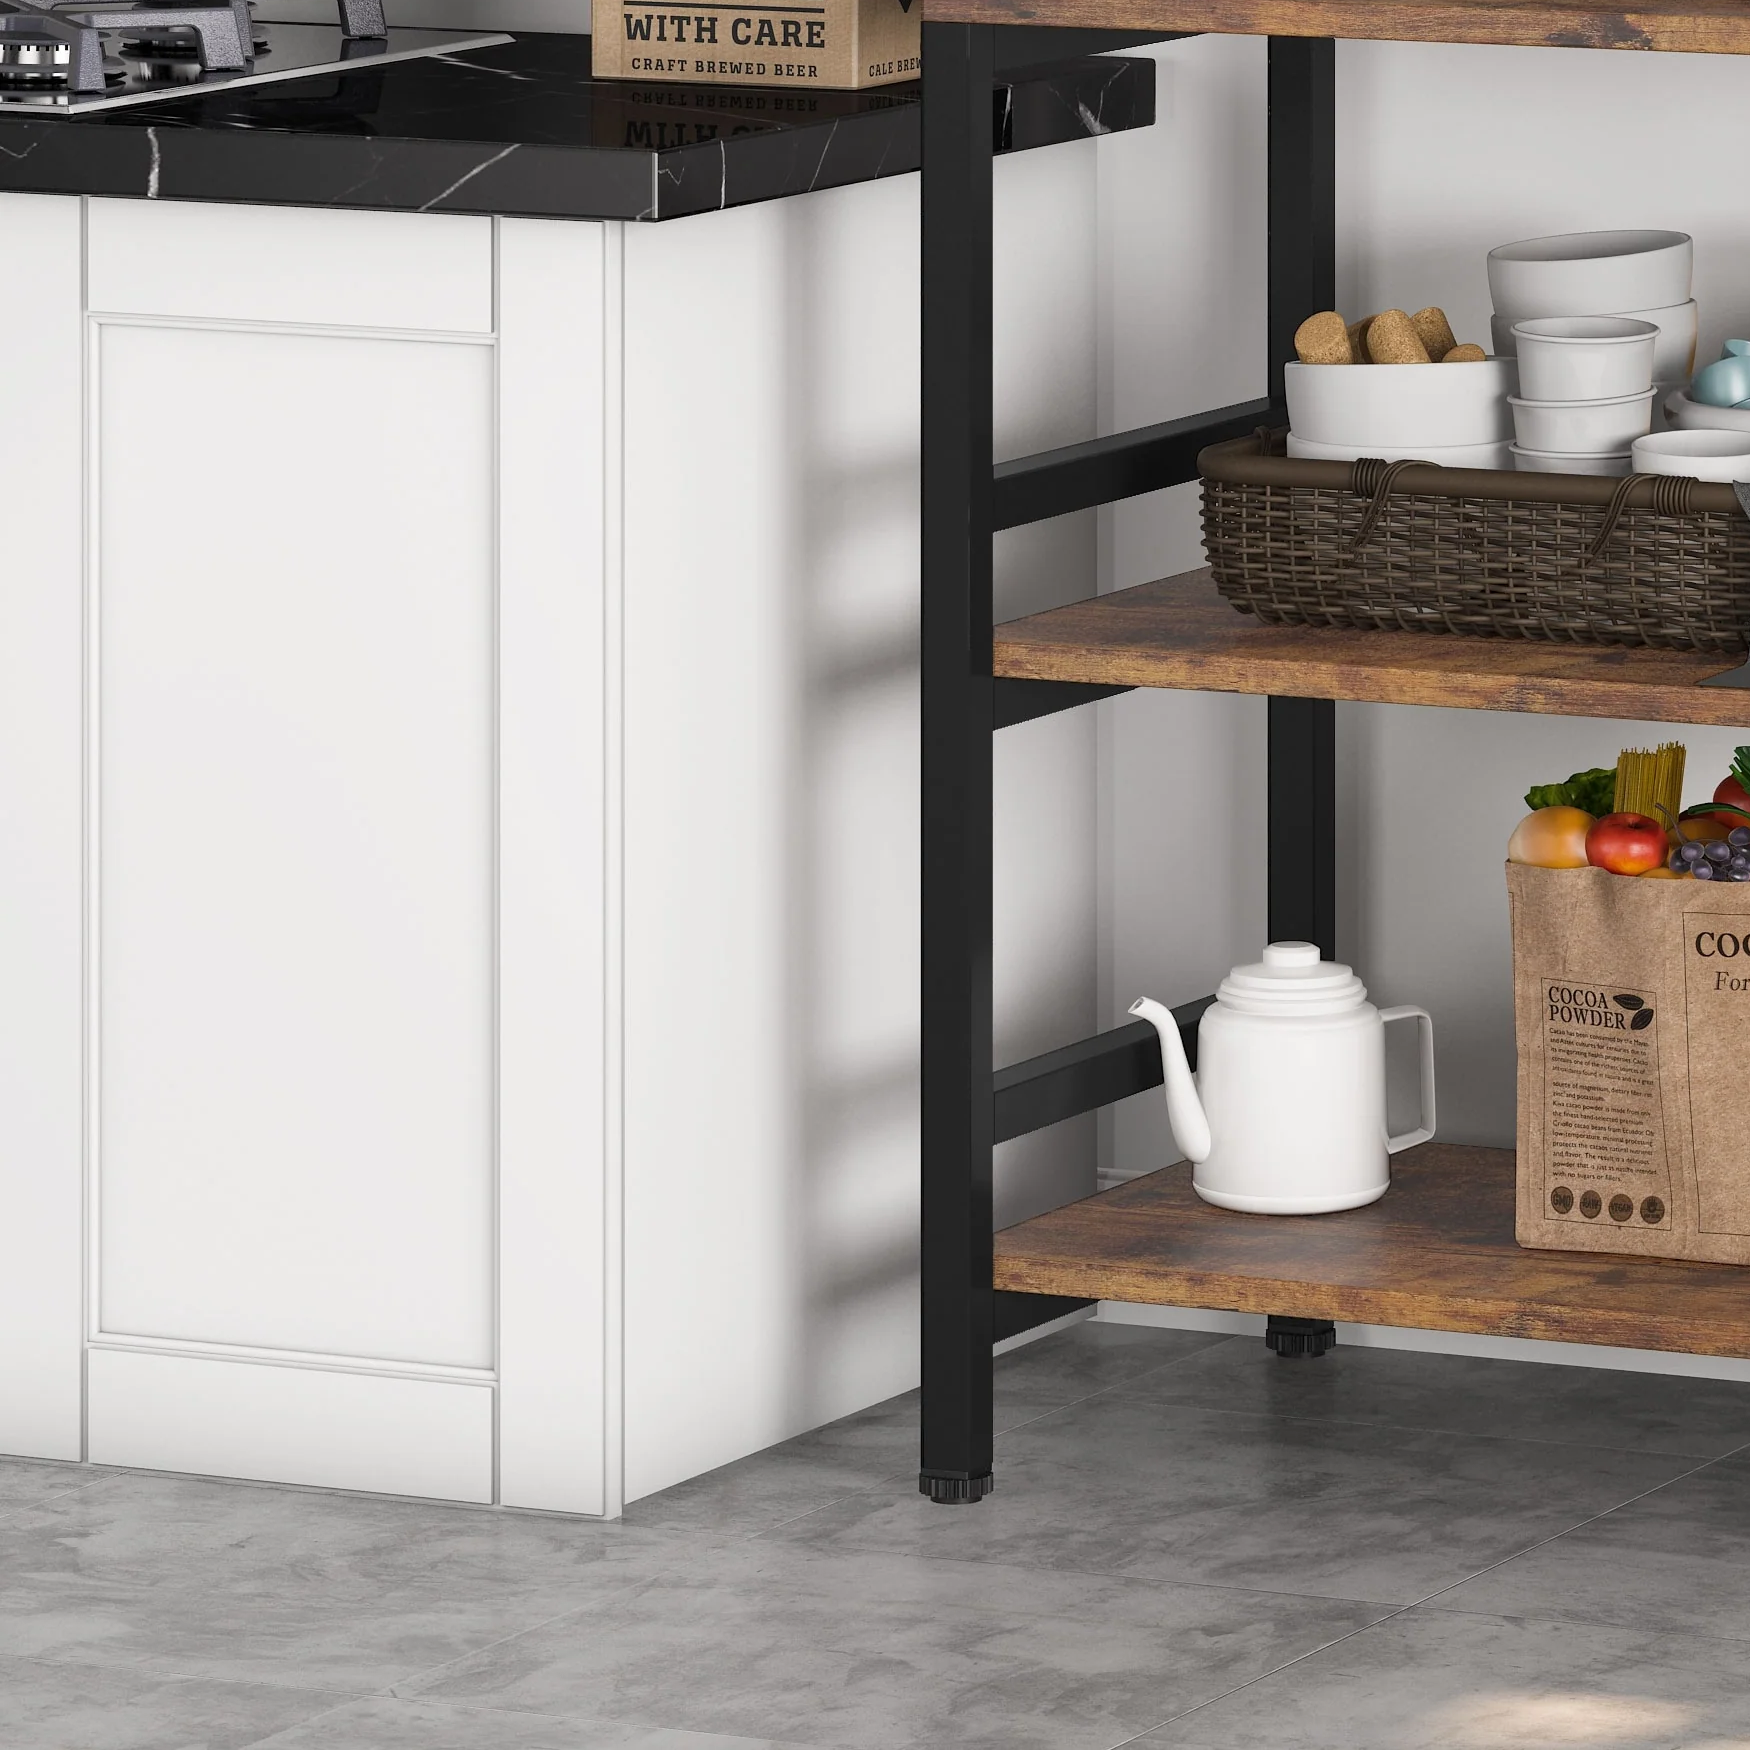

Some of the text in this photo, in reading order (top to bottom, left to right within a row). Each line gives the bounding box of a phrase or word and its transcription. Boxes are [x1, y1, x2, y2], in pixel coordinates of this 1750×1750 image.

[624, 13, 826, 48] WITH CARE
[631, 58, 818, 78] CRAFT BREWED BEER
[869, 62, 894, 77] CALE
[1714, 971, 1750, 991] For
[1548, 986, 1608, 1009] COCOA
[1549, 1004, 1626, 1030] POWDER
